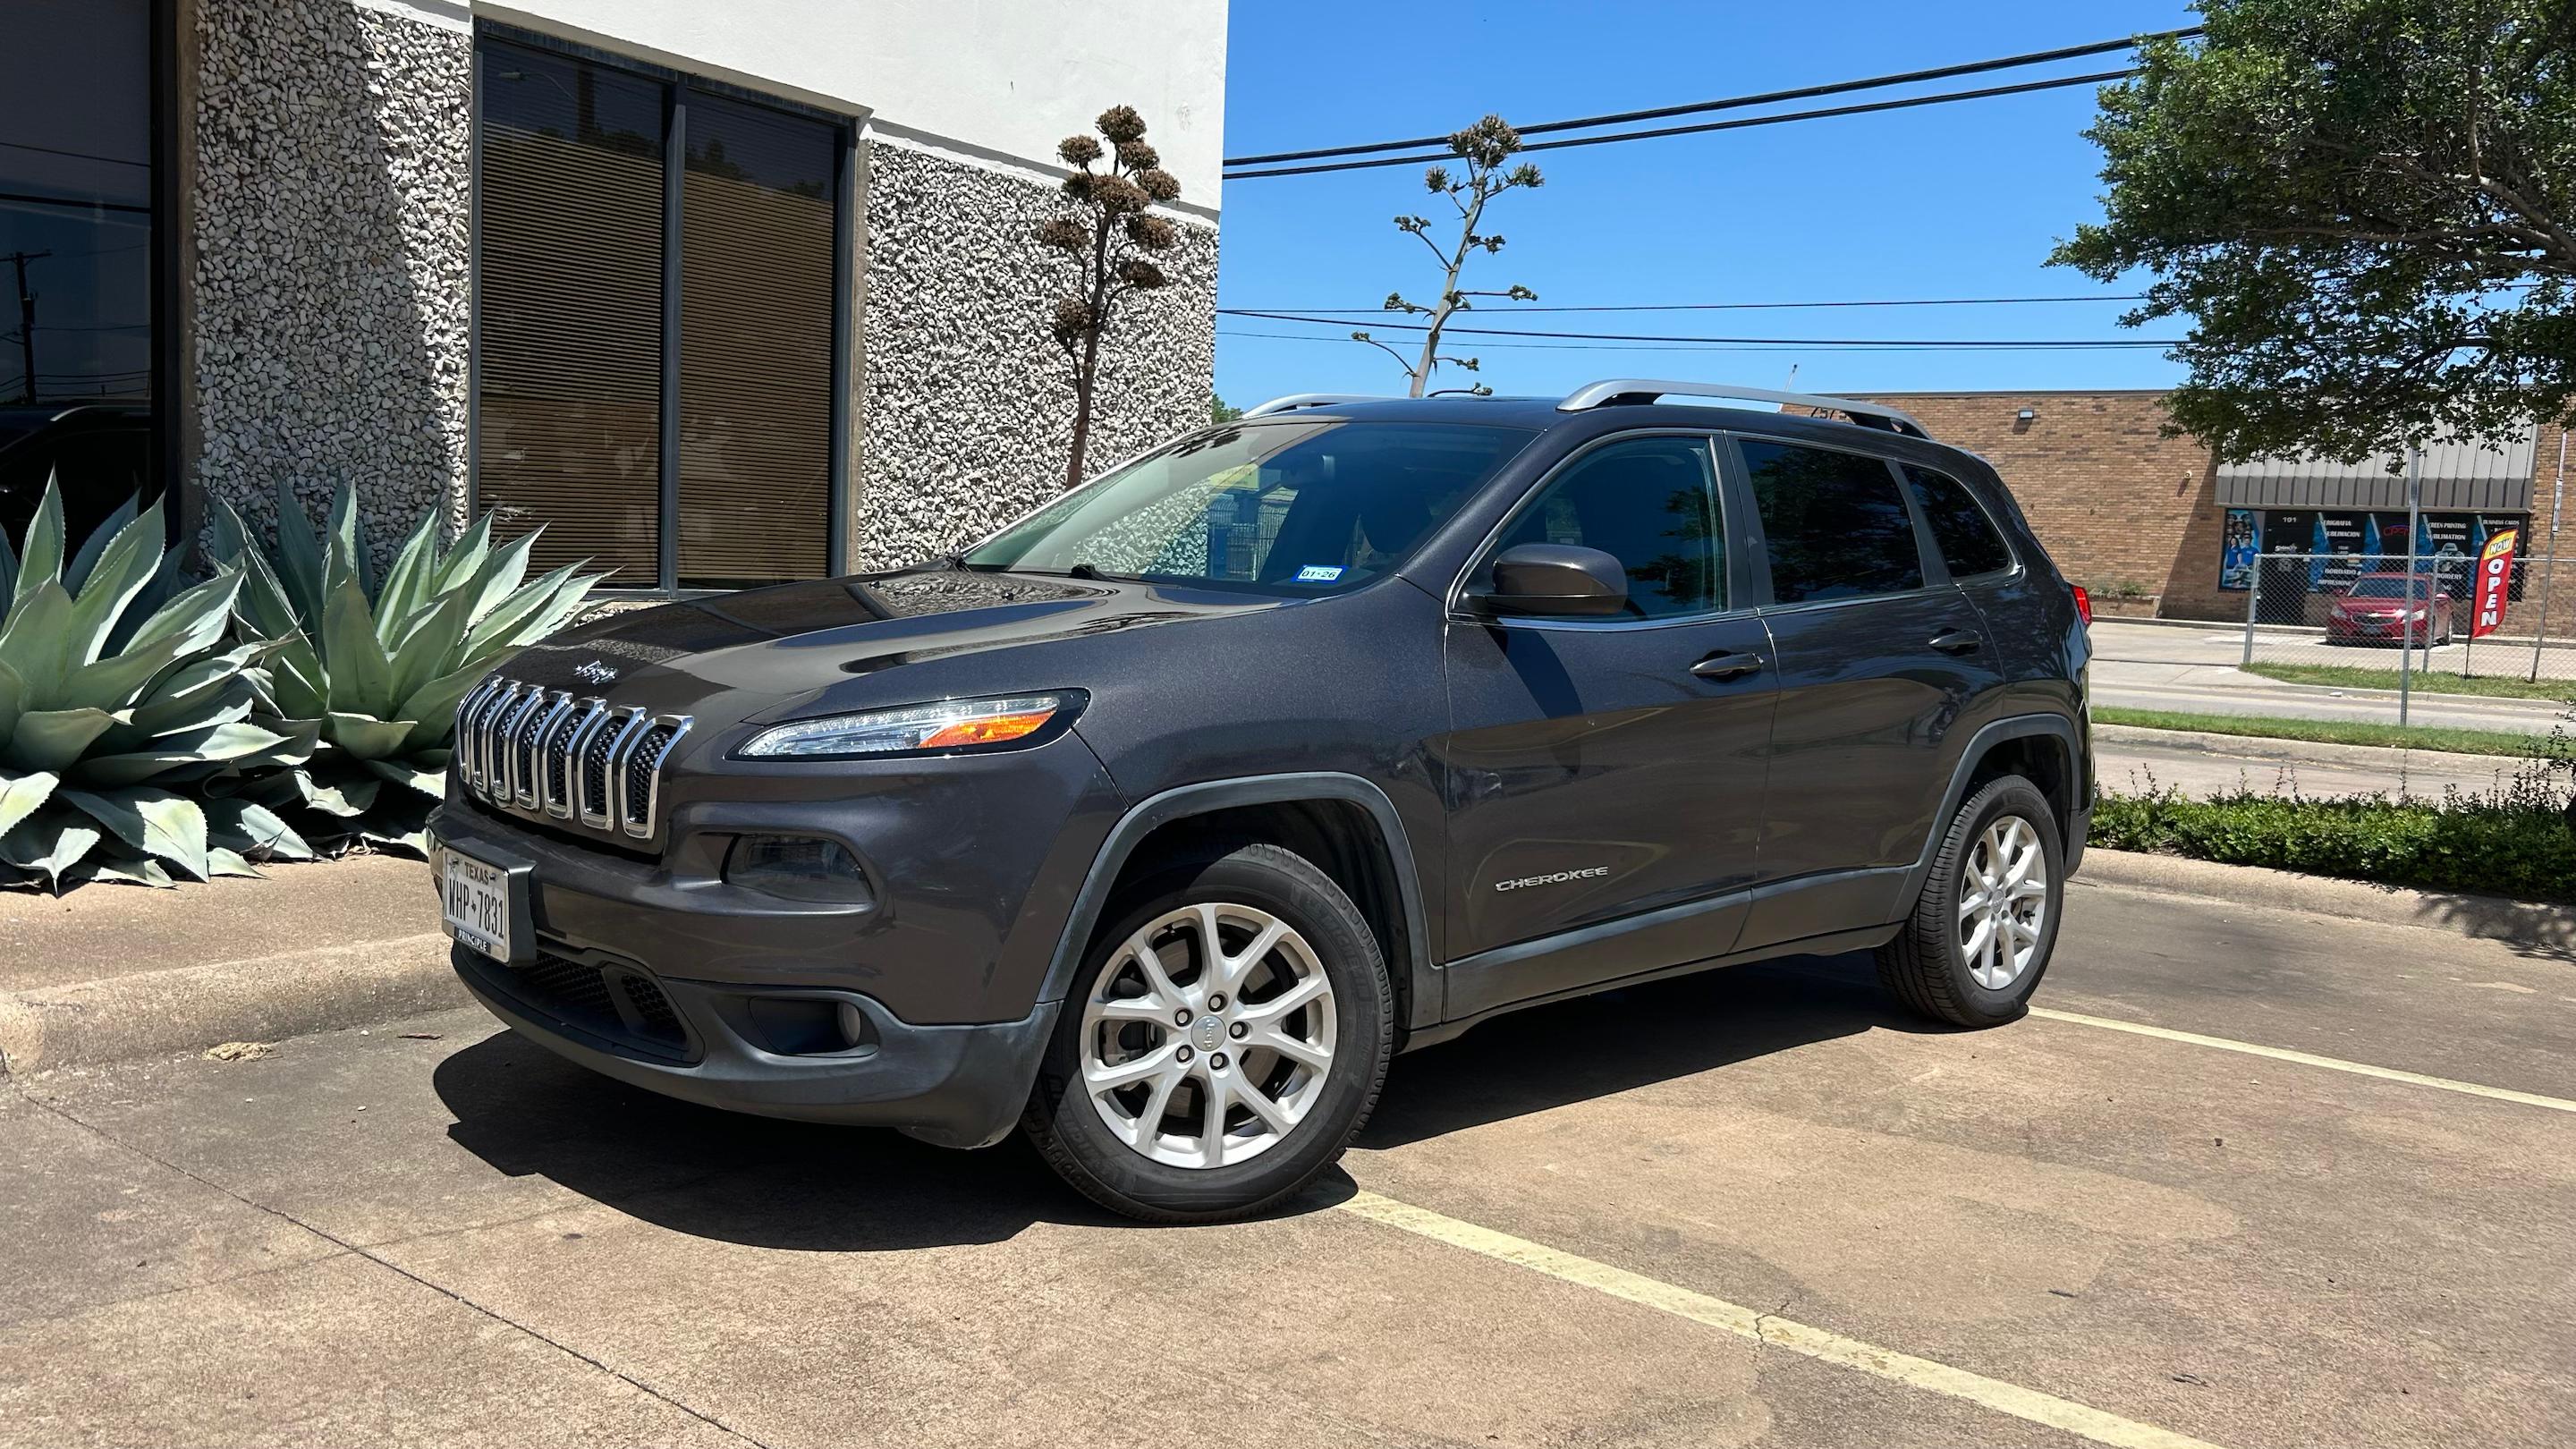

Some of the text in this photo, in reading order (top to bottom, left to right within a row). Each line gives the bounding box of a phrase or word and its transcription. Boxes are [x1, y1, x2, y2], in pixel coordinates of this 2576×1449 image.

[2489, 538, 2512, 555] NOW
[2480, 558, 2504, 627] OPEN
[464, 861, 489, 886] TEXAS
[1496, 866, 1608, 891] CHEROKEE
[457, 928, 487, 952] PRINCIPLE
